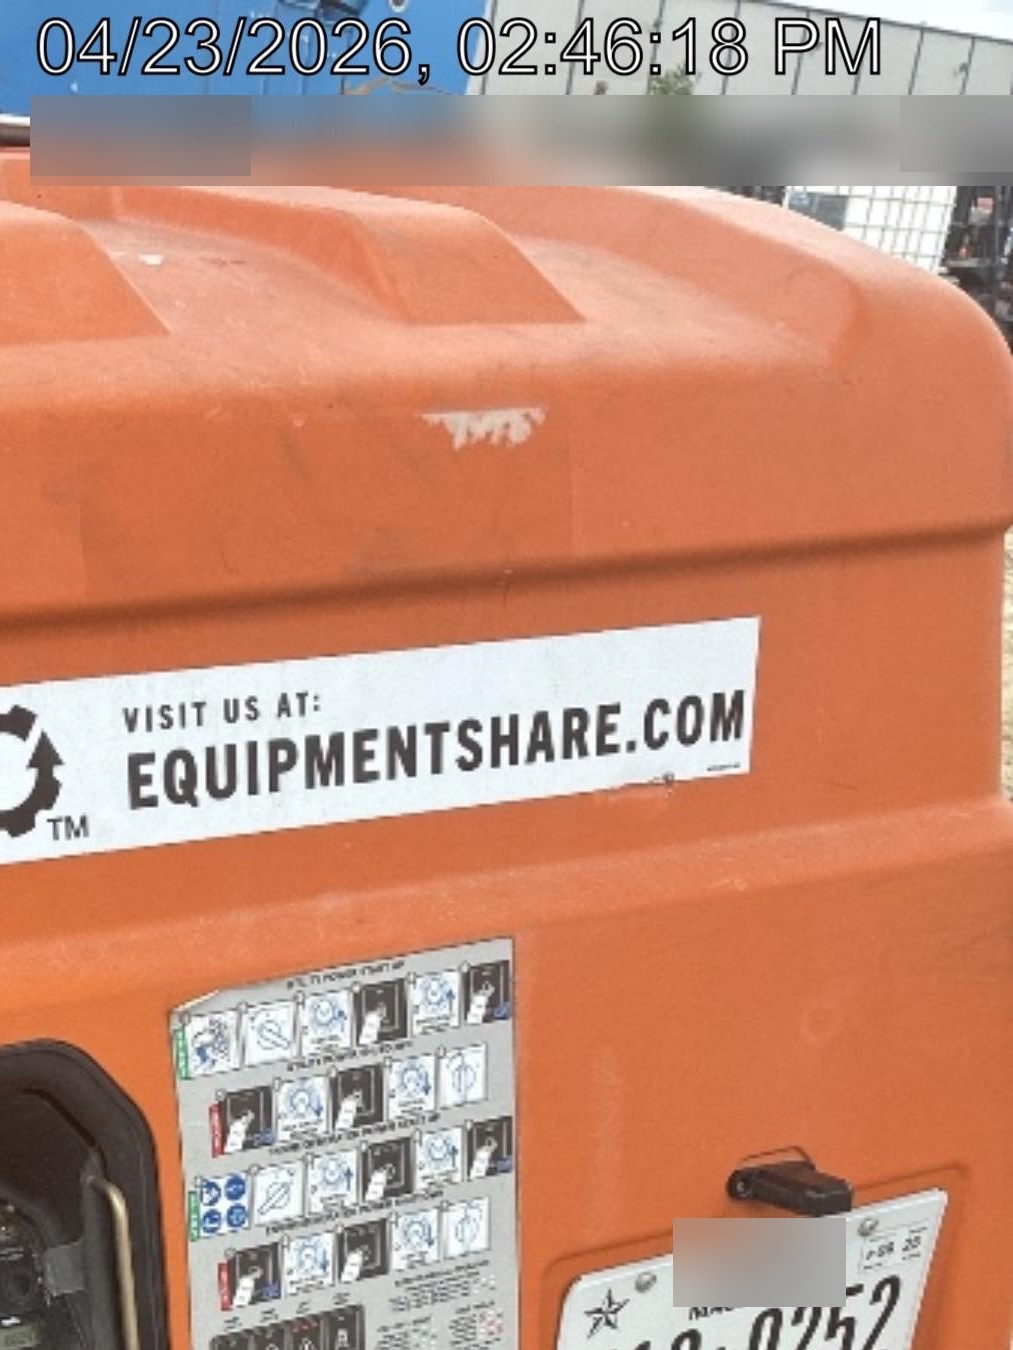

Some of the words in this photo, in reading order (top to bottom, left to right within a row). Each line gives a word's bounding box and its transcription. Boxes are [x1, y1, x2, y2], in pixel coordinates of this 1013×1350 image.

[122, 701, 208, 733] VISIT
[223, 697, 261, 724] US
[276, 691, 321, 719] AT:
[126, 689, 747, 812] EQUIPMENTSHARE.COM
[47, 814, 90, 842] TM
